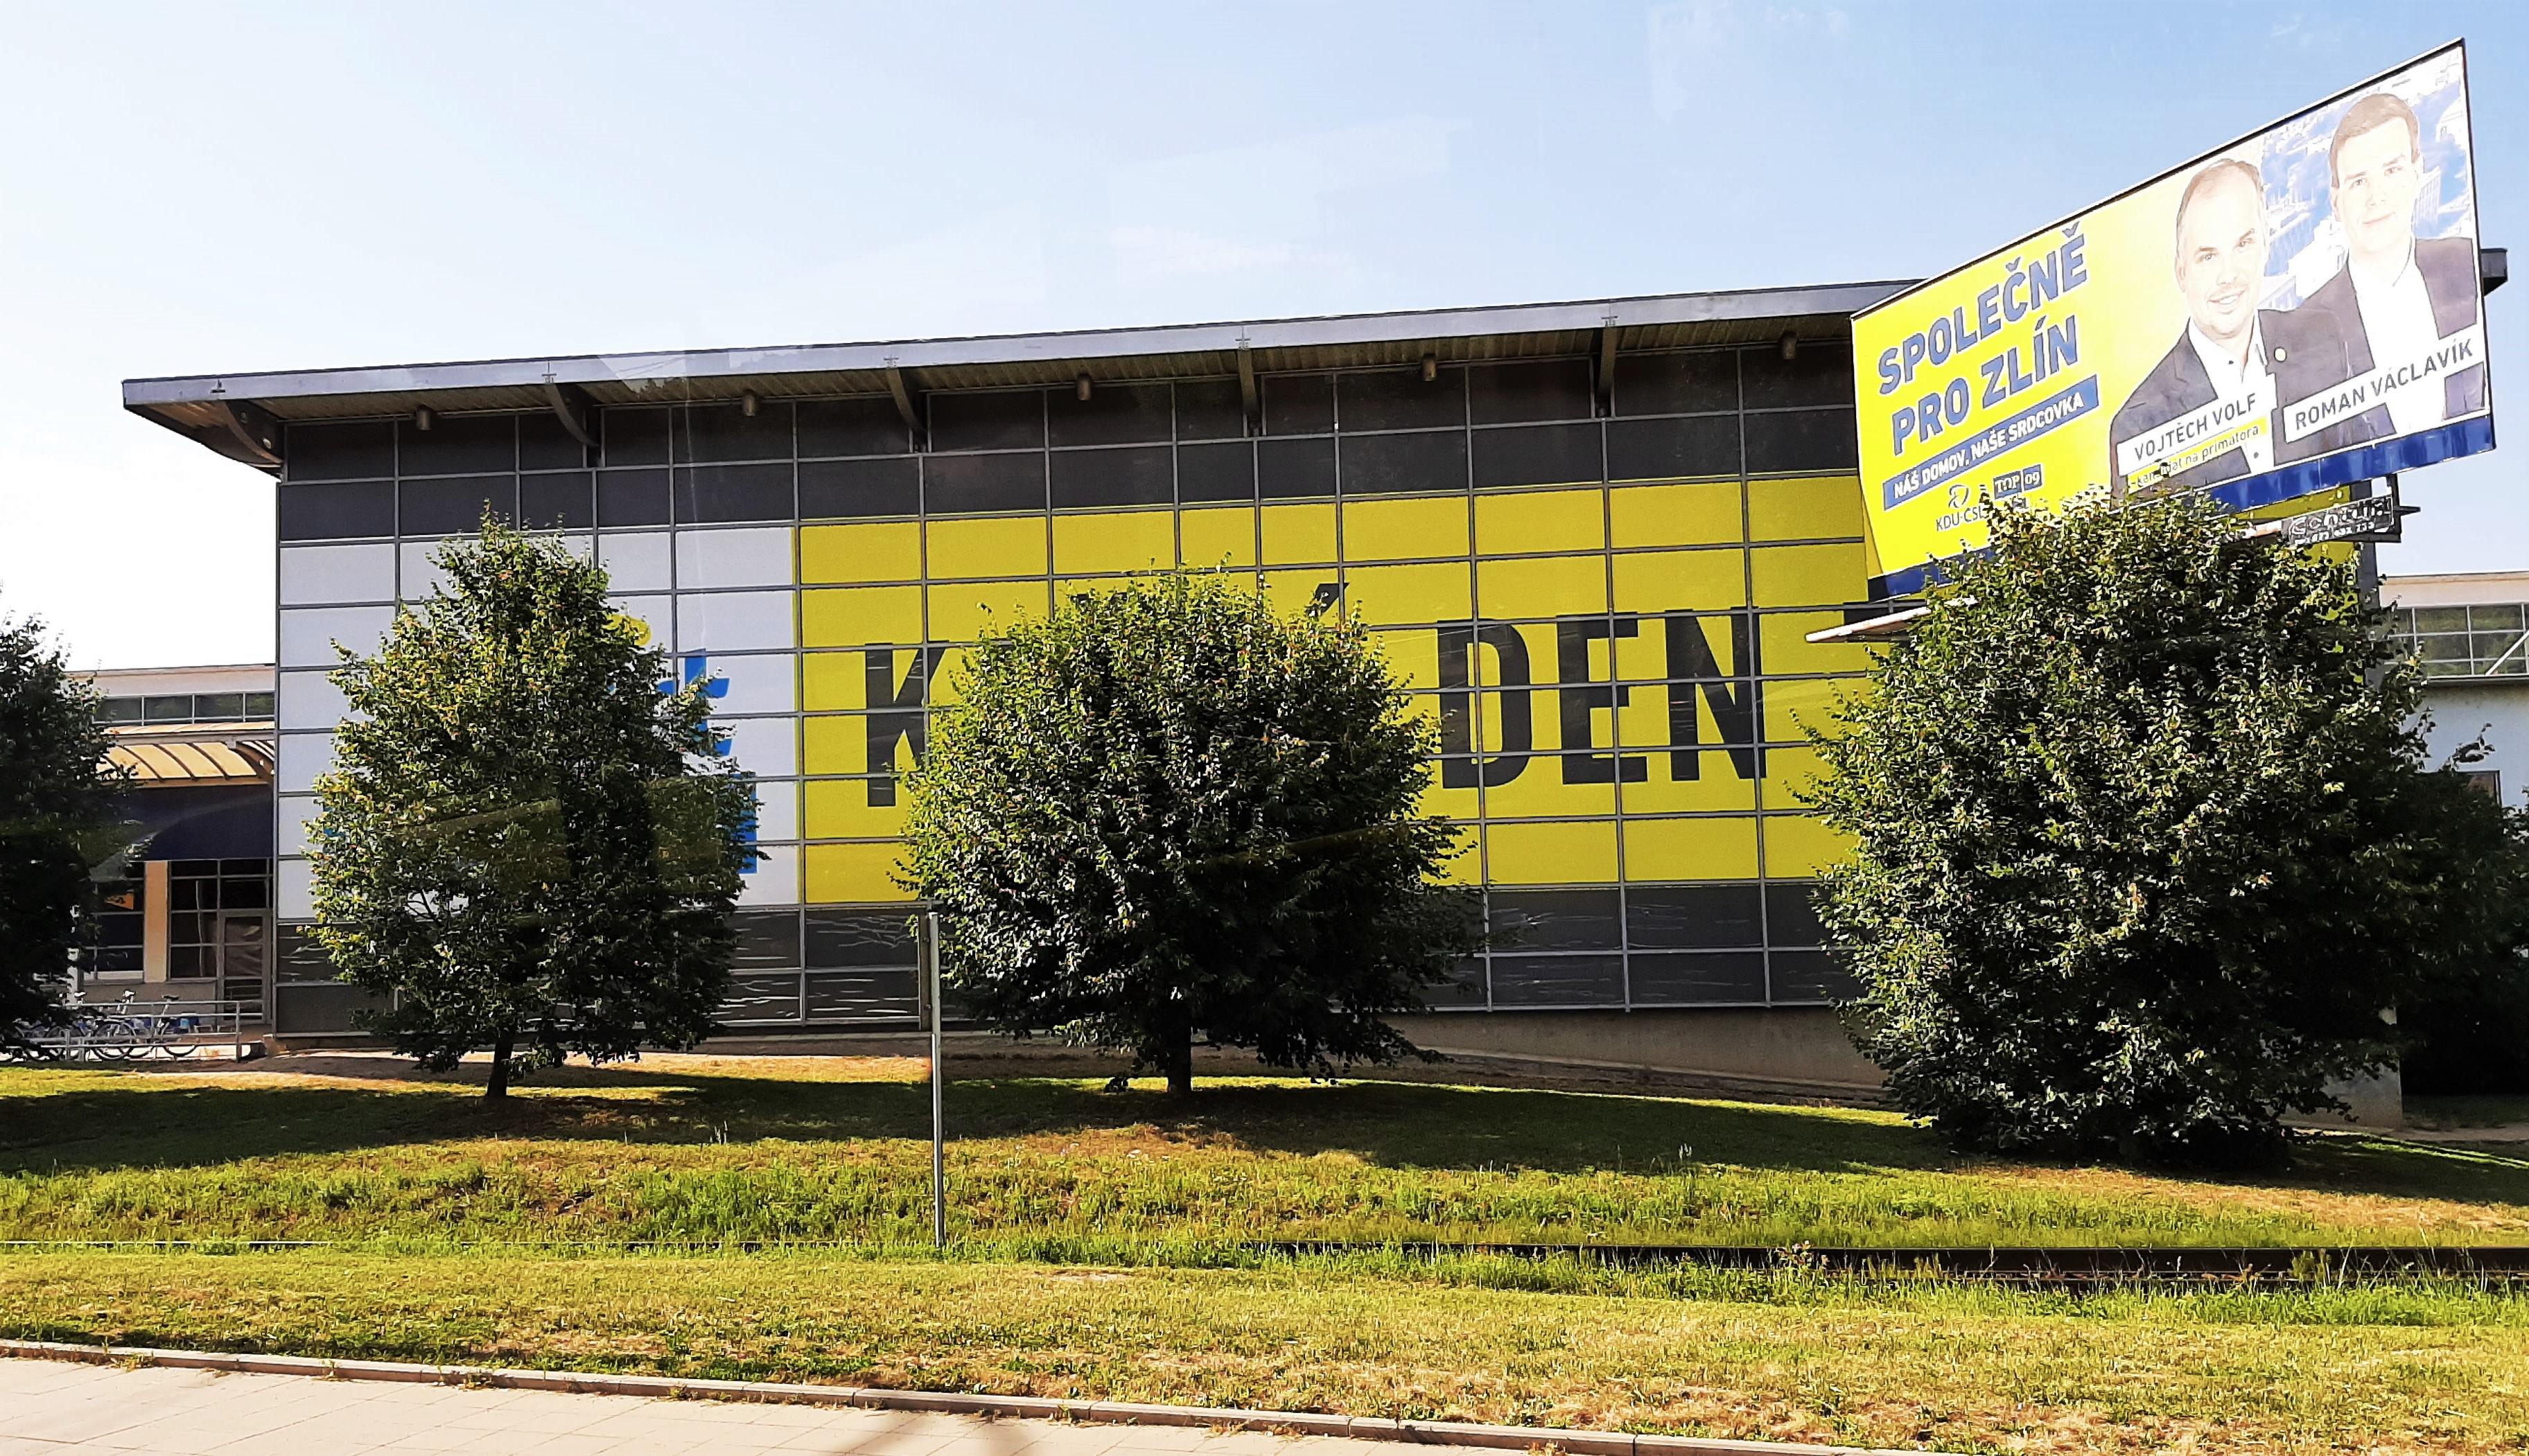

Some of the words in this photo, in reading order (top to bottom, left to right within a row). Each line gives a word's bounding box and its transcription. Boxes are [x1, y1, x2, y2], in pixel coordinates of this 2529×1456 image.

[1878, 221, 2088, 395] SPOLEČNĚ
[1891, 377, 1970, 457] PRO
[1981, 315, 2079, 409] ZLÍN
[2134, 414, 2208, 462] VOJTĚCH
[2212, 392, 2256, 426] VOLF
[2295, 385, 2365, 430] ROMAN
[2370, 337, 2473, 397] VÁCLAVÍK
[1893, 468, 1920, 500] NÁŠ
[1970, 428, 2007, 459] NAŠE
[2008, 392, 2085, 443] SRDCOVKA
[1994, 474, 2020, 494] TOP
[2024, 471, 2040, 485] 09
[2185, 453, 2198, 466] na
[2201, 425, 2259, 462] primátora
[1437, 605, 1767, 789] DEN
